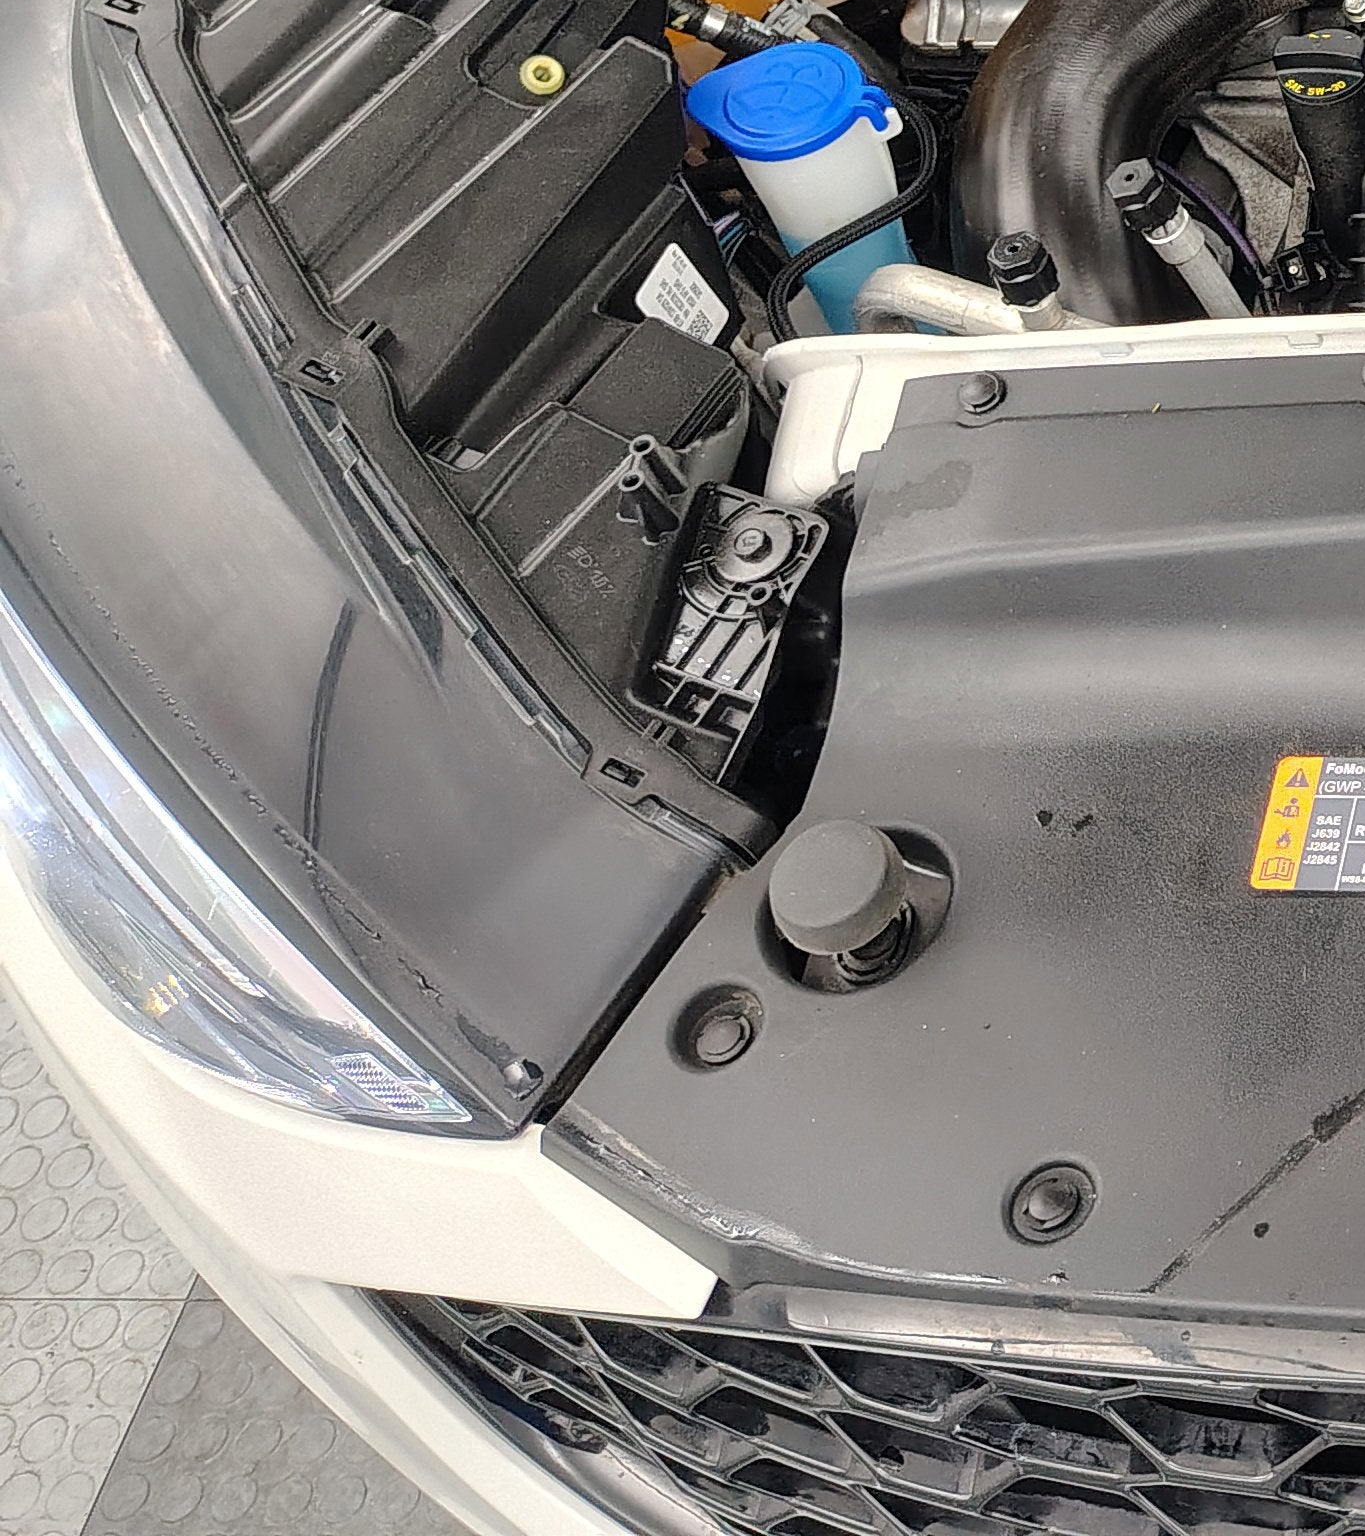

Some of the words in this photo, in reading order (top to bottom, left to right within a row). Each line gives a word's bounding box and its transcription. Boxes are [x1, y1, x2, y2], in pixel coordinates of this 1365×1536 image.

[1285, 79, 1305, 93] SAE
[1307, 80, 1346, 96] 5W-30
[1319, 781, 1362, 794] (GWP
[1316, 816, 1342, 825] SAE
[1312, 829, 1340, 838] J639
[1306, 842, 1340, 852] J2842
[1303, 855, 1337, 865] J2845
